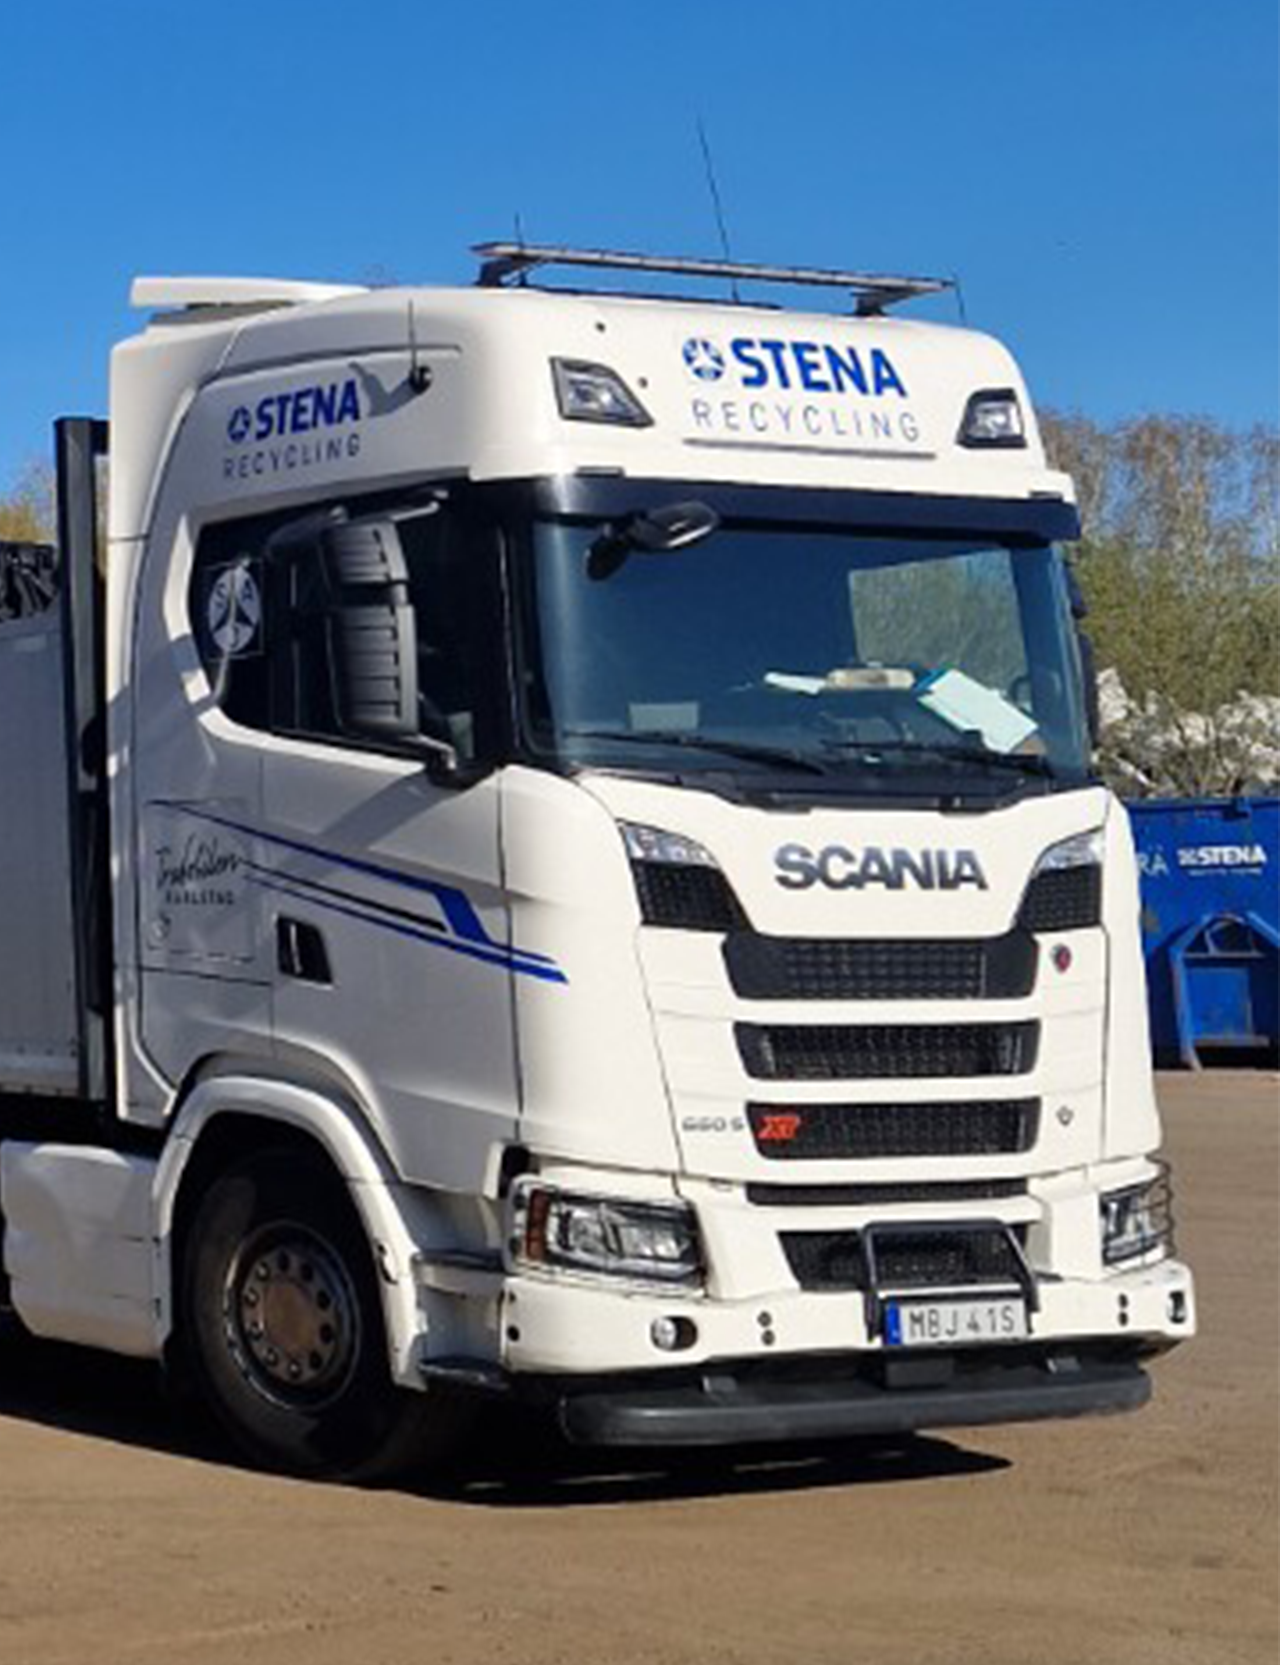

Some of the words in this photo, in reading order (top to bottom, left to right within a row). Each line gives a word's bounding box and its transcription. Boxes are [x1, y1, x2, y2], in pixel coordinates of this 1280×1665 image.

[730, 338, 907, 397] STENA
[255, 378, 361, 440] STENA
[692, 398, 920, 442] RECYCLING
[223, 433, 361, 479] RECYCLING
[774, 843, 989, 891] SCANIA
[1197, 843, 1268, 867] STENA
[908, 1307, 959, 1339] MBJ
